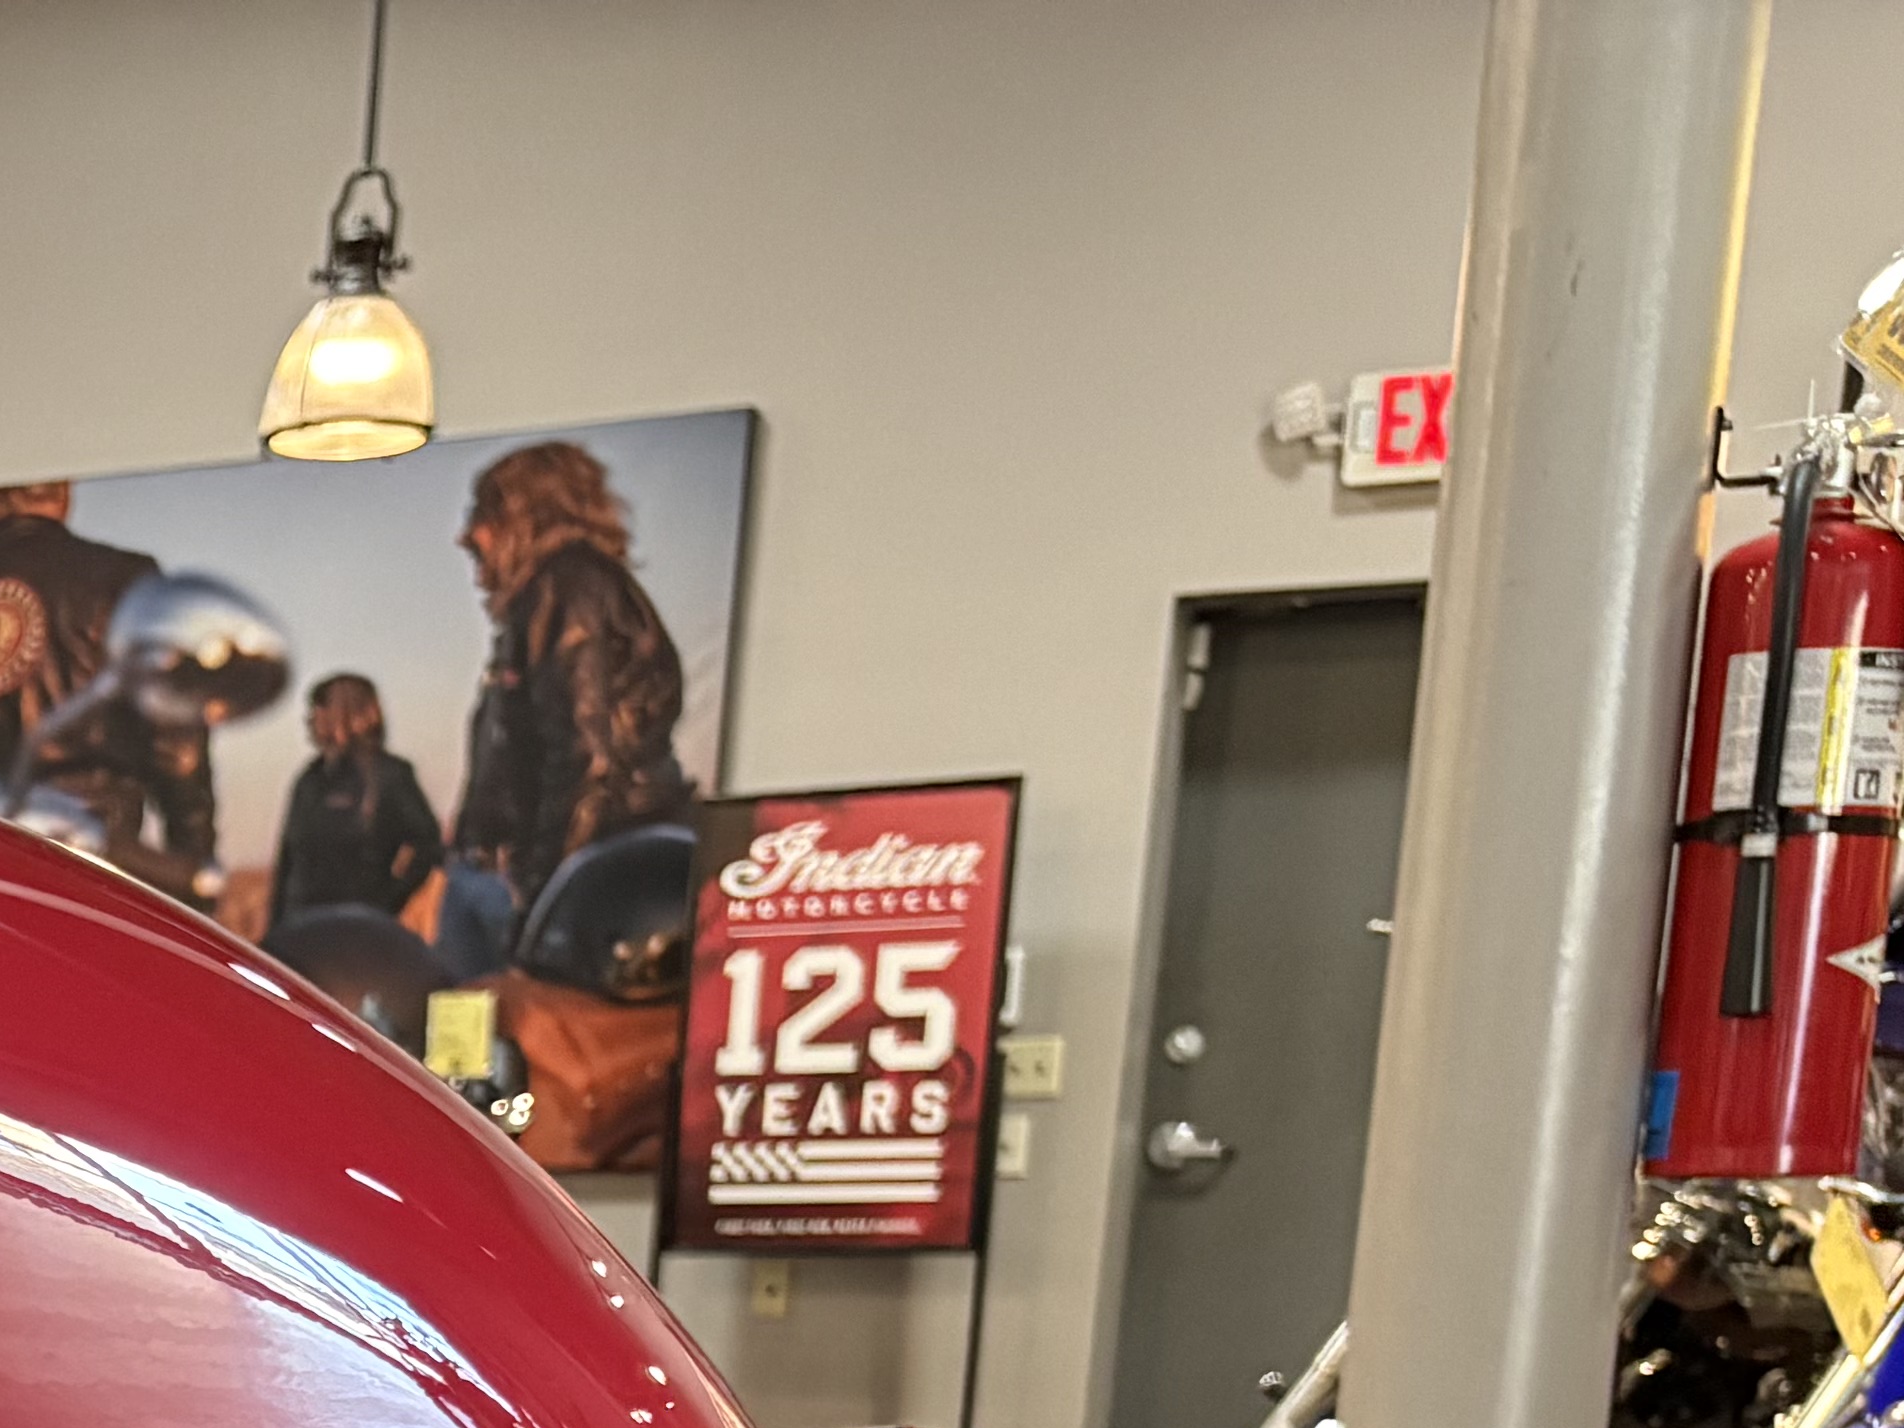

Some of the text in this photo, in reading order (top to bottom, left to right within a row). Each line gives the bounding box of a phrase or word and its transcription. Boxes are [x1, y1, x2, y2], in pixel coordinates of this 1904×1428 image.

[1376, 372, 1455, 466] EX
[720, 820, 985, 898] Indian
[727, 889, 970, 921] MOTORCYCLE
[714, 940, 961, 1075] 125
[714, 1079, 949, 1137] YEARS
